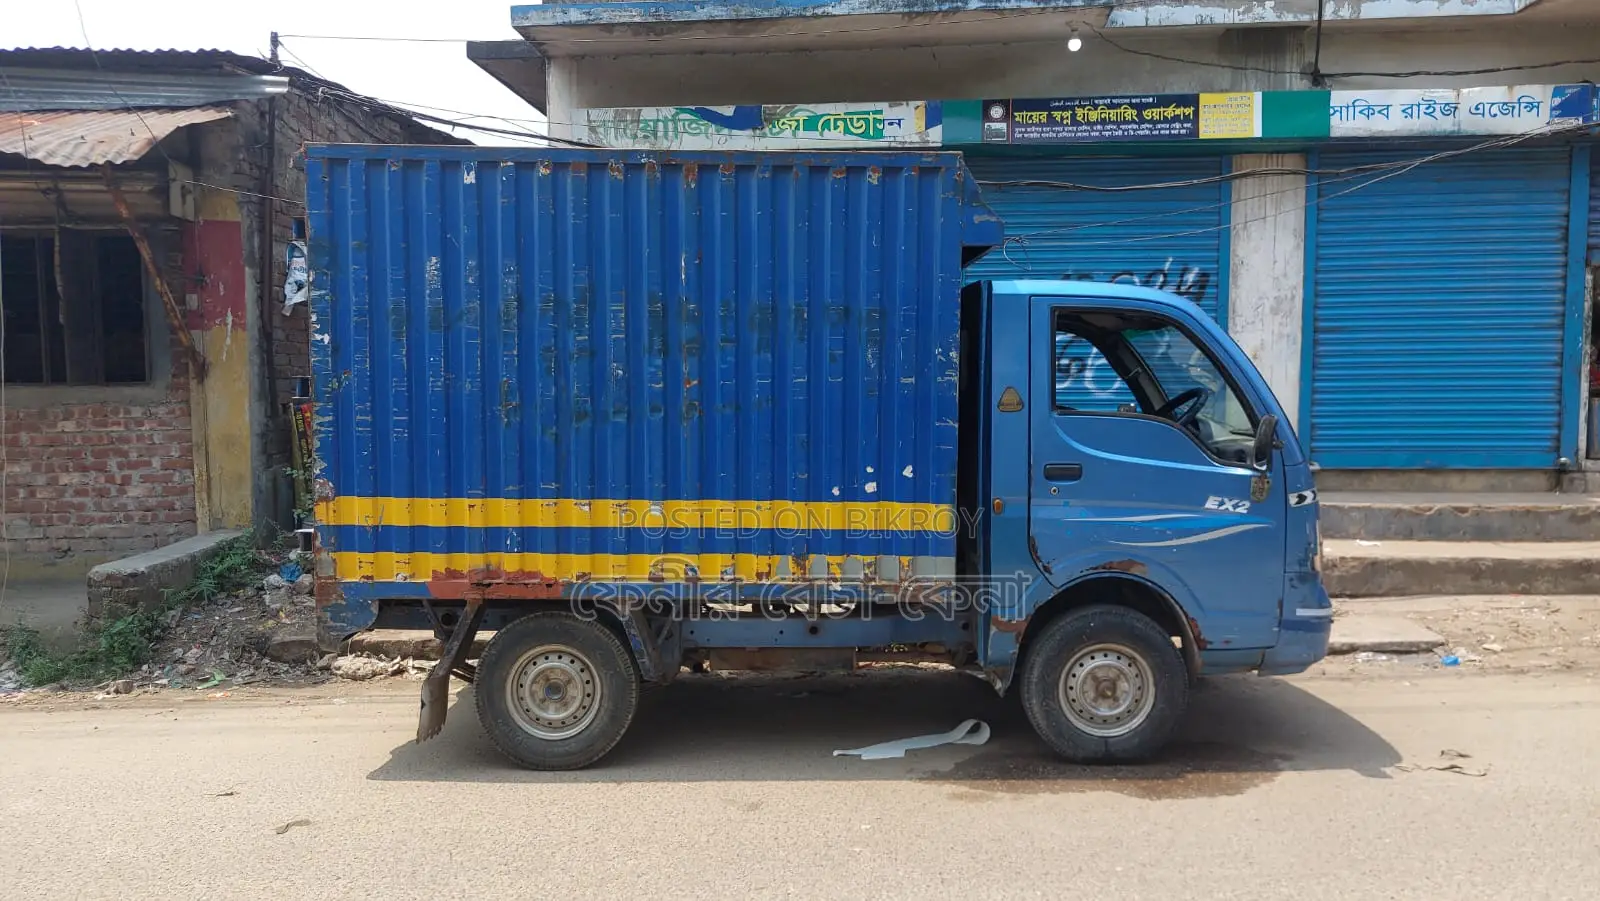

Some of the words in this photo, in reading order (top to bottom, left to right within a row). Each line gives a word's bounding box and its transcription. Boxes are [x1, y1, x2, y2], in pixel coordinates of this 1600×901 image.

[1013, 110, 1048, 124] মায়ের
[1051, 110, 1072, 125] স্বপ্ন
[1075, 105, 1138, 123] ইঞ্জিনিয়ারিং
[1142, 103, 1195, 121] ওয়ার্কশপ
[1329, 98, 1392, 122] সাকিব
[1400, 97, 1460, 121] রাইজ
[1469, 95, 1543, 119] এজেন্সি
[1204, 496, 1250, 514] EX2
